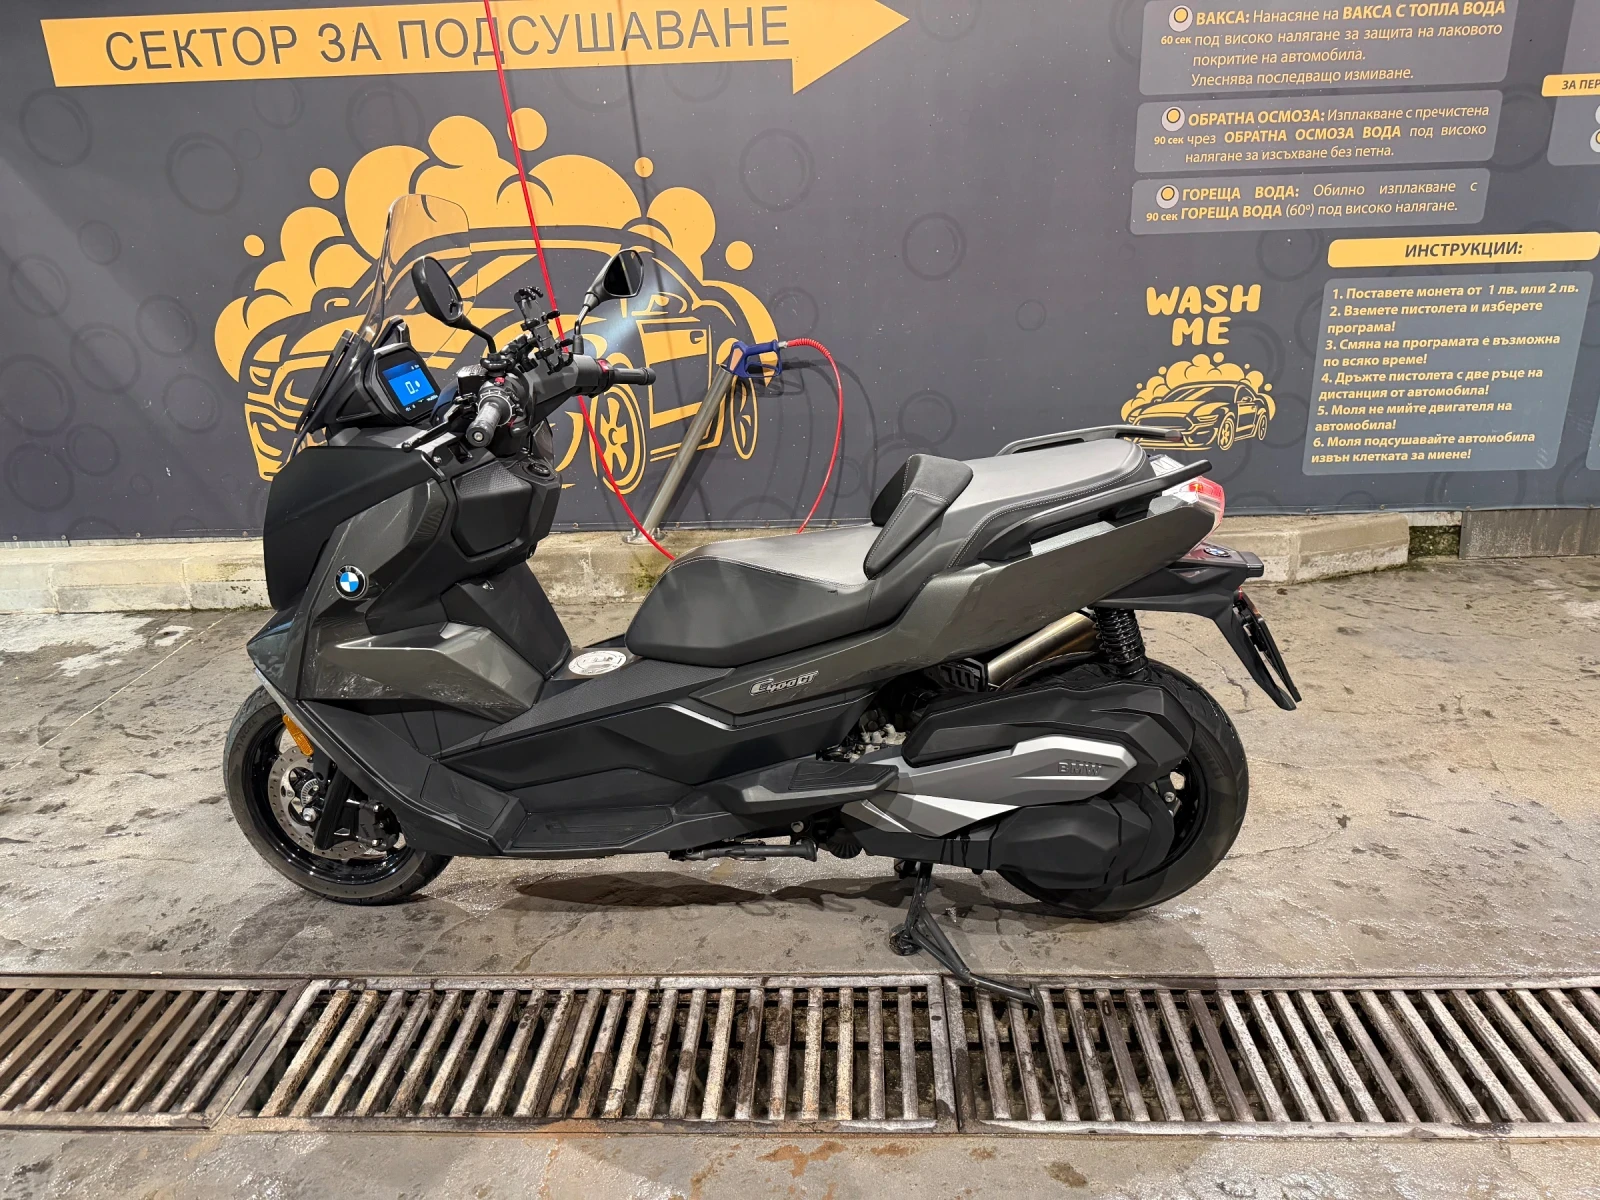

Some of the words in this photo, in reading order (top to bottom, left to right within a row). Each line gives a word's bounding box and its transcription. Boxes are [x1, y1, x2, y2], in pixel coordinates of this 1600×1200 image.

[1196, 10, 1250, 26] ВАКСА:
[1253, 9, 1320, 23] Нанасяне
[1322, 10, 1339, 20] на
[1342, 4, 1392, 20] ВАКСА
[1395, 3, 1407, 18] С
[1409, 2, 1459, 17] ТОПЛА
[1462, 0, 1505, 18] ВОДА
[105, 26, 298, 71] СЕКТОР
[317, 22, 382, 62] ЗА
[397, 5, 790, 65] ПОДСУШАВАНЕ
[1161, 35, 1174, 45] 60
[1174, 36, 1192, 44] сек
[1194, 35, 1220, 48] под
[1224, 33, 1273, 45] високо
[1277, 30, 1340, 43] налягане
[1344, 30, 1359, 40] за
[1363, 28, 1413, 41] защита
[1417, 27, 1434, 38] на
[1437, 24, 1503, 37] лаковото
[1193, 54, 1258, 69] покритие
[1261, 53, 1278, 64] на
[1280, 47, 1366, 63] автомобила.
[1191, 73, 1253, 88] Улеснява
[1256, 71, 1341, 86] последващо
[1344, 68, 1414, 81] измиване.
[1561, 80, 1577, 90] ЗА
[1188, 111, 1255, 126] ОБРАТНА
[1257, 108, 1325, 124] ОСМОЗА:
[1327, 109, 1404, 121] Изплакване
[1405, 109, 1413, 119] с
[1415, 106, 1489, 121] пречистена
[1154, 135, 1167, 145] 90
[1167, 136, 1184, 145] сек
[1187, 134, 1216, 148] чрез
[1224, 129, 1287, 143] ОБРАТНА
[1295, 127, 1355, 141] ОСМОЗА
[1362, 125, 1401, 141] ВОДА
[1409, 127, 1434, 139] под
[1441, 125, 1487, 136] високо
[1185, 152, 1243, 163] налягане
[1245, 151, 1259, 161] за
[1261, 149, 1328, 161] изсъхване
[1330, 145, 1352, 158] без
[1355, 147, 1394, 157] петна.
[1182, 187, 1241, 202] ГОРЕЩА
[1254, 185, 1299, 201] ВОДА:
[1313, 183, 1365, 197] Обилно
[1379, 182, 1456, 195] изплакване
[1470, 182, 1478, 192] с
[1146, 212, 1159, 222] 90
[1160, 213, 1178, 221] сек
[1181, 206, 1239, 221] ГОРЕЩА
[1242, 204, 1282, 220] ВОДА
[1317, 205, 1342, 217] под
[1345, 203, 1392, 215] високо
[1395, 201, 1458, 213] налягане.
[1404, 241, 1523, 259] ИНСТРУКЦИИ:
[1146, 284, 1262, 316] WASH
[1332, 288, 1344, 300] 1.
[1346, 287, 1414, 300] Поставете
[1416, 287, 1464, 297] монета
[1467, 286, 1483, 296] от
[1489, 284, 1495, 295] 1
[1497, 286, 1518, 295] лв.
[1520, 285, 1546, 294] или
[1548, 283, 1557, 293] 2
[1558, 285, 1579, 293] лв.
[1329, 306, 1341, 317] 2.
[1343, 305, 1399, 317] Вземете
[1401, 304, 1468, 315] пистолета
[1470, 304, 1479, 313] и
[1481, 300, 1543, 314] изберете
[1171, 316, 1232, 346] ME
[1327, 320, 1396, 336] програма!
[1324, 339, 1337, 351] 3.
[1339, 338, 1382, 350] Смяна
[1383, 340, 1400, 349] на
[1402, 337, 1480, 351] програмата
[1482, 338, 1490, 346] е
[1492, 335, 1561, 346] възможна
[1323, 358, 1340, 367] по
[1342, 357, 1380, 367] всяко
[1382, 353, 1428, 368] време!
[1320, 372, 1333, 384] 4.
[1334, 372, 1388, 386] Дръжте
[1388, 371, 1454, 382] пистолета
[1456, 371, 1464, 380] с
[1464, 370, 1490, 381] две
[1491, 369, 1526, 382] ръце
[1527, 369, 1543, 378] на
[1318, 389, 1388, 402] дистанция
[1390, 389, 1406, 398] от
[1406, 384, 1490, 397] автомобила!
[1317, 405, 1329, 416] 5.
[1331, 404, 1366, 416] Моля
[1368, 406, 1385, 415] не
[1386, 402, 1427, 414] мийте
[1428, 403, 1495, 415] двигателя
[1496, 402, 1513, 411] на
[1314, 419, 1397, 432] автомобила!
[1312, 437, 1325, 448] 6.
[1326, 436, 1362, 447] Моля
[1363, 433, 1456, 448] подсушавайте
[1457, 431, 1535, 444] автомобила
[1311, 454, 1350, 463] извън
[1352, 452, 1409, 462] клетката
[1410, 452, 1425, 460] за
[1427, 448, 1472, 460] миене!
[1058, 762, 1102, 776] BMW
